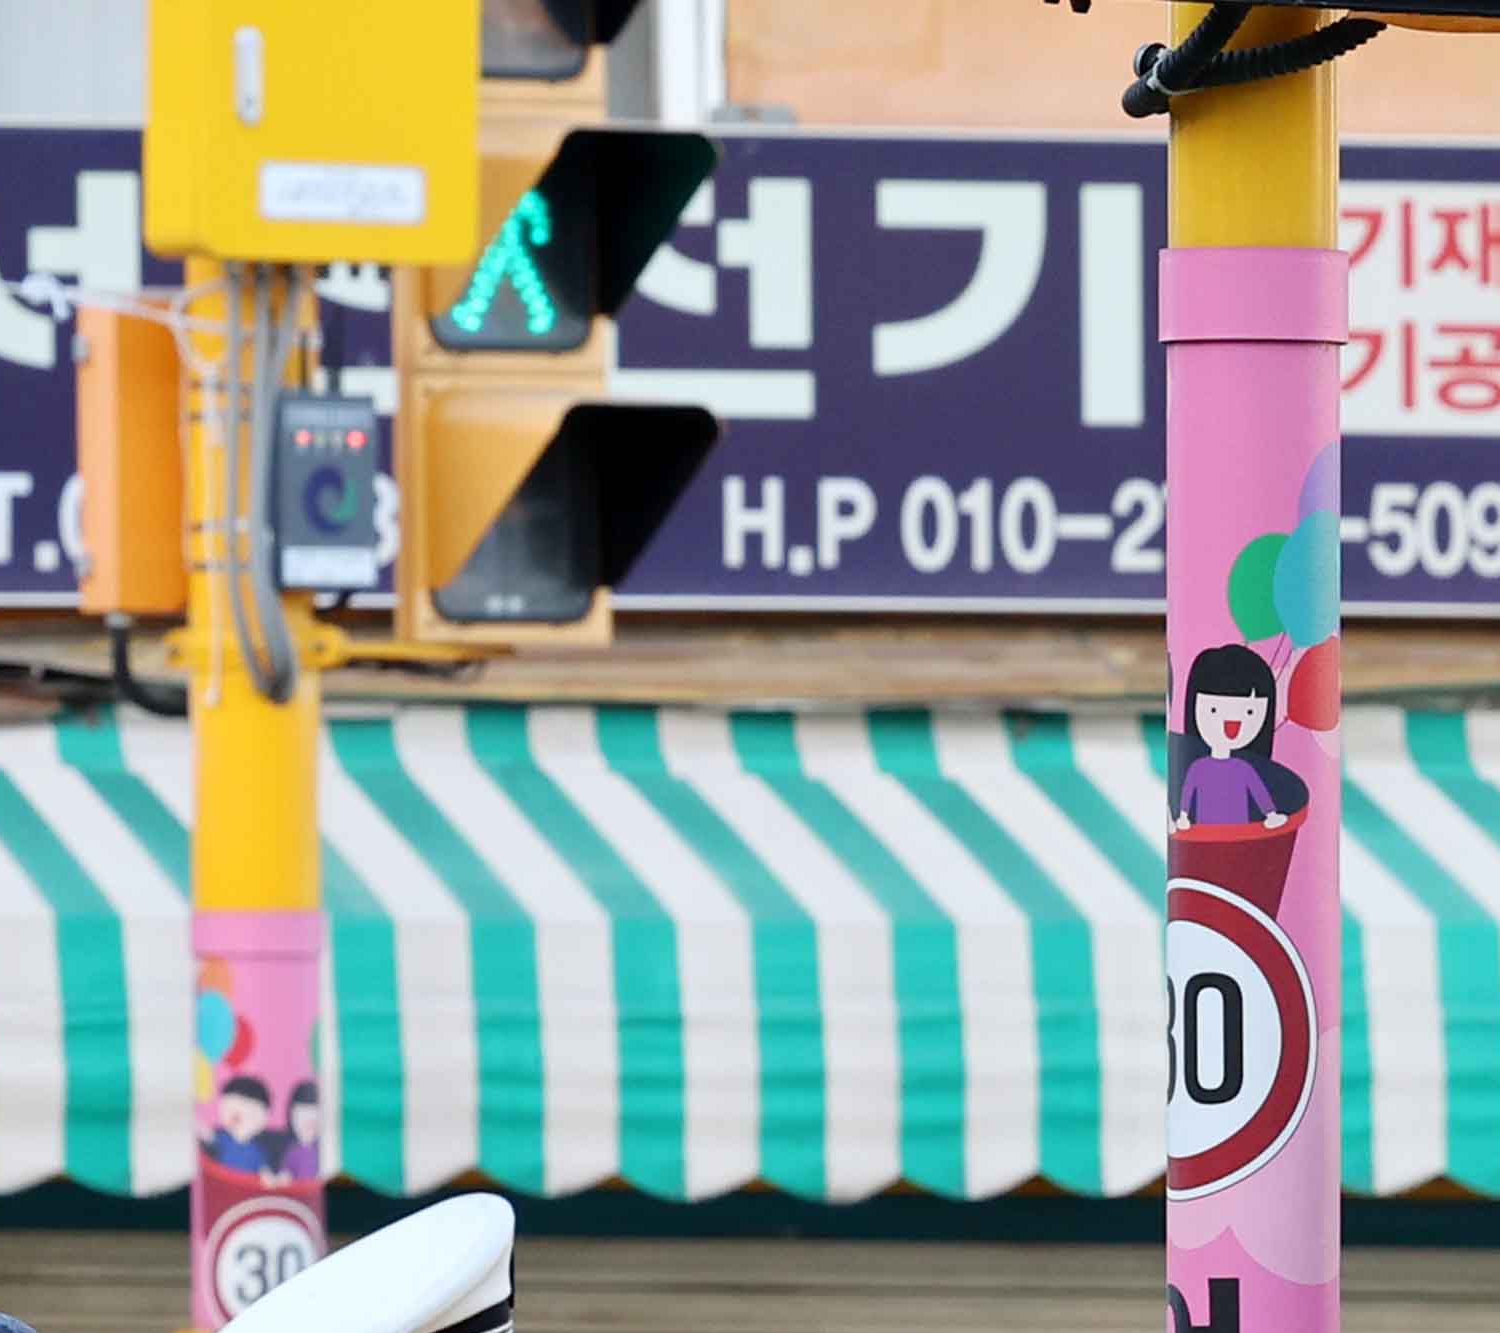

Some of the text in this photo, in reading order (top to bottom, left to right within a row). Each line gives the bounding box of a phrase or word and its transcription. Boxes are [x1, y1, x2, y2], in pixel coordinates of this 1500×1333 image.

[722, 475, 876, 578] H.P
[1167, 971, 1245, 1105] 0
[235, 1244, 306, 1304] 30
